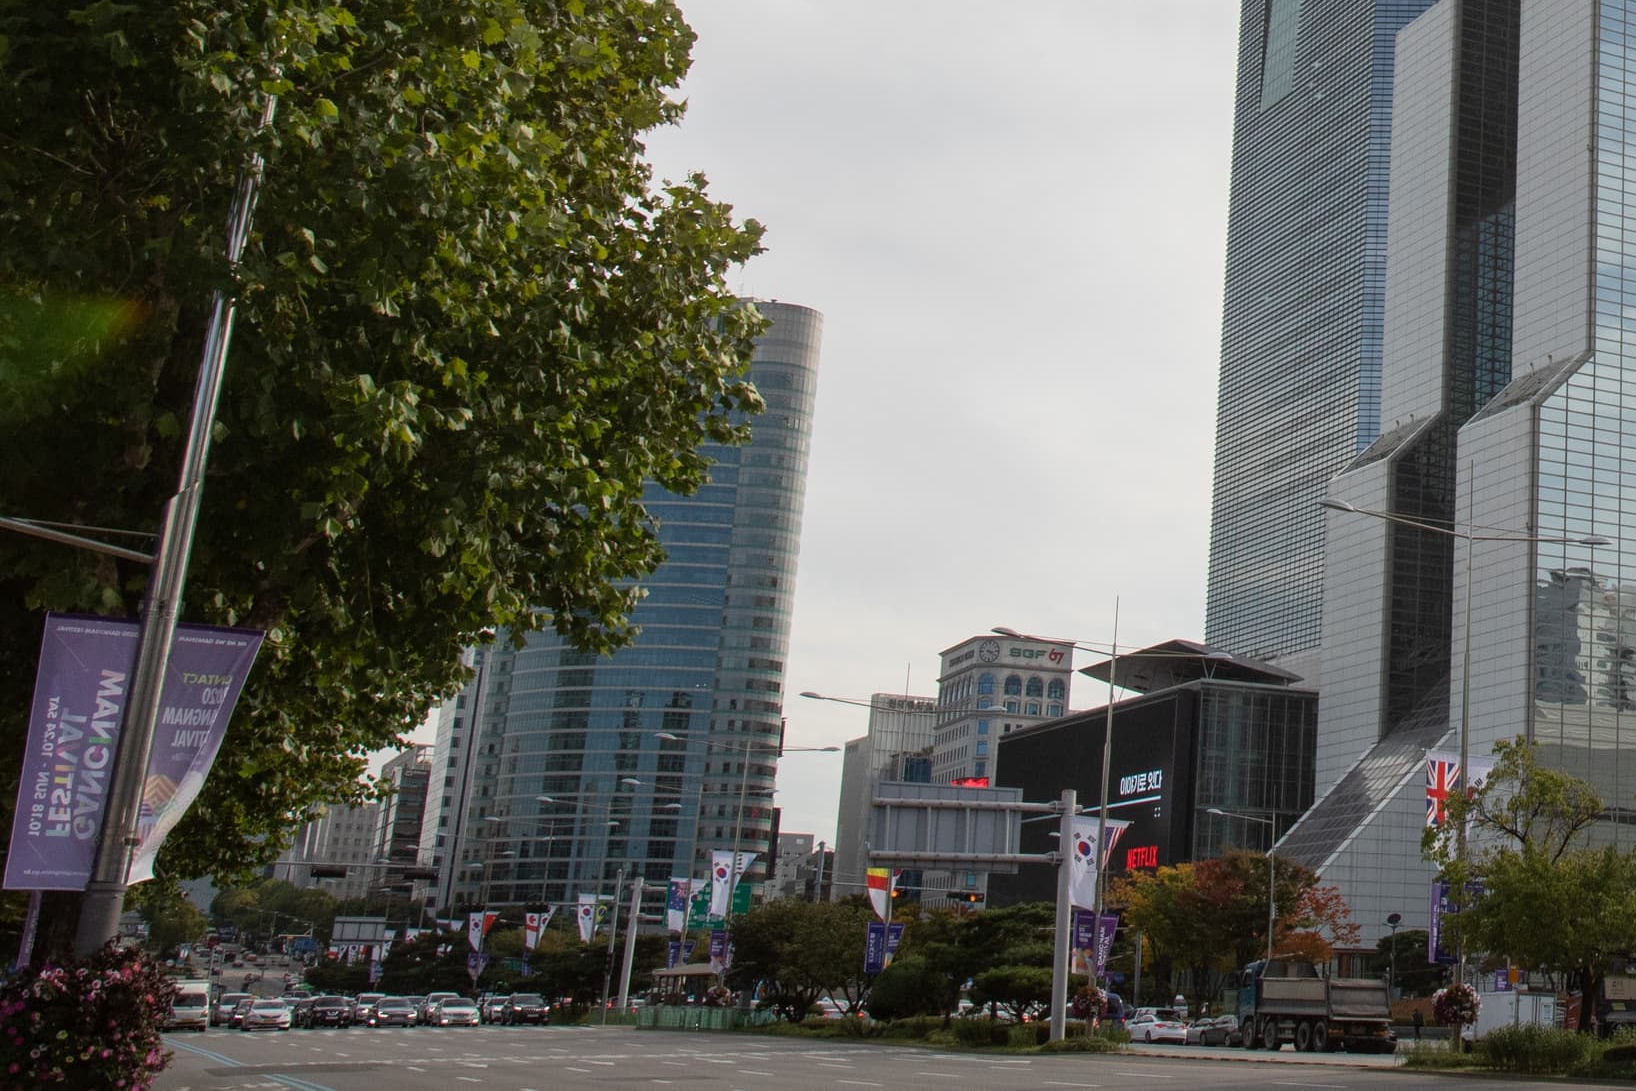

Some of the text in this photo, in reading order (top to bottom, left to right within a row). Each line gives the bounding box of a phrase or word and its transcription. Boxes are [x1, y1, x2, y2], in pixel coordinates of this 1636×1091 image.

[1009, 647, 1064, 664] SGF 67
[1120, 769, 1162, 796] 이야기로 잇다
[1126, 845, 1159, 869] NETFLIX
